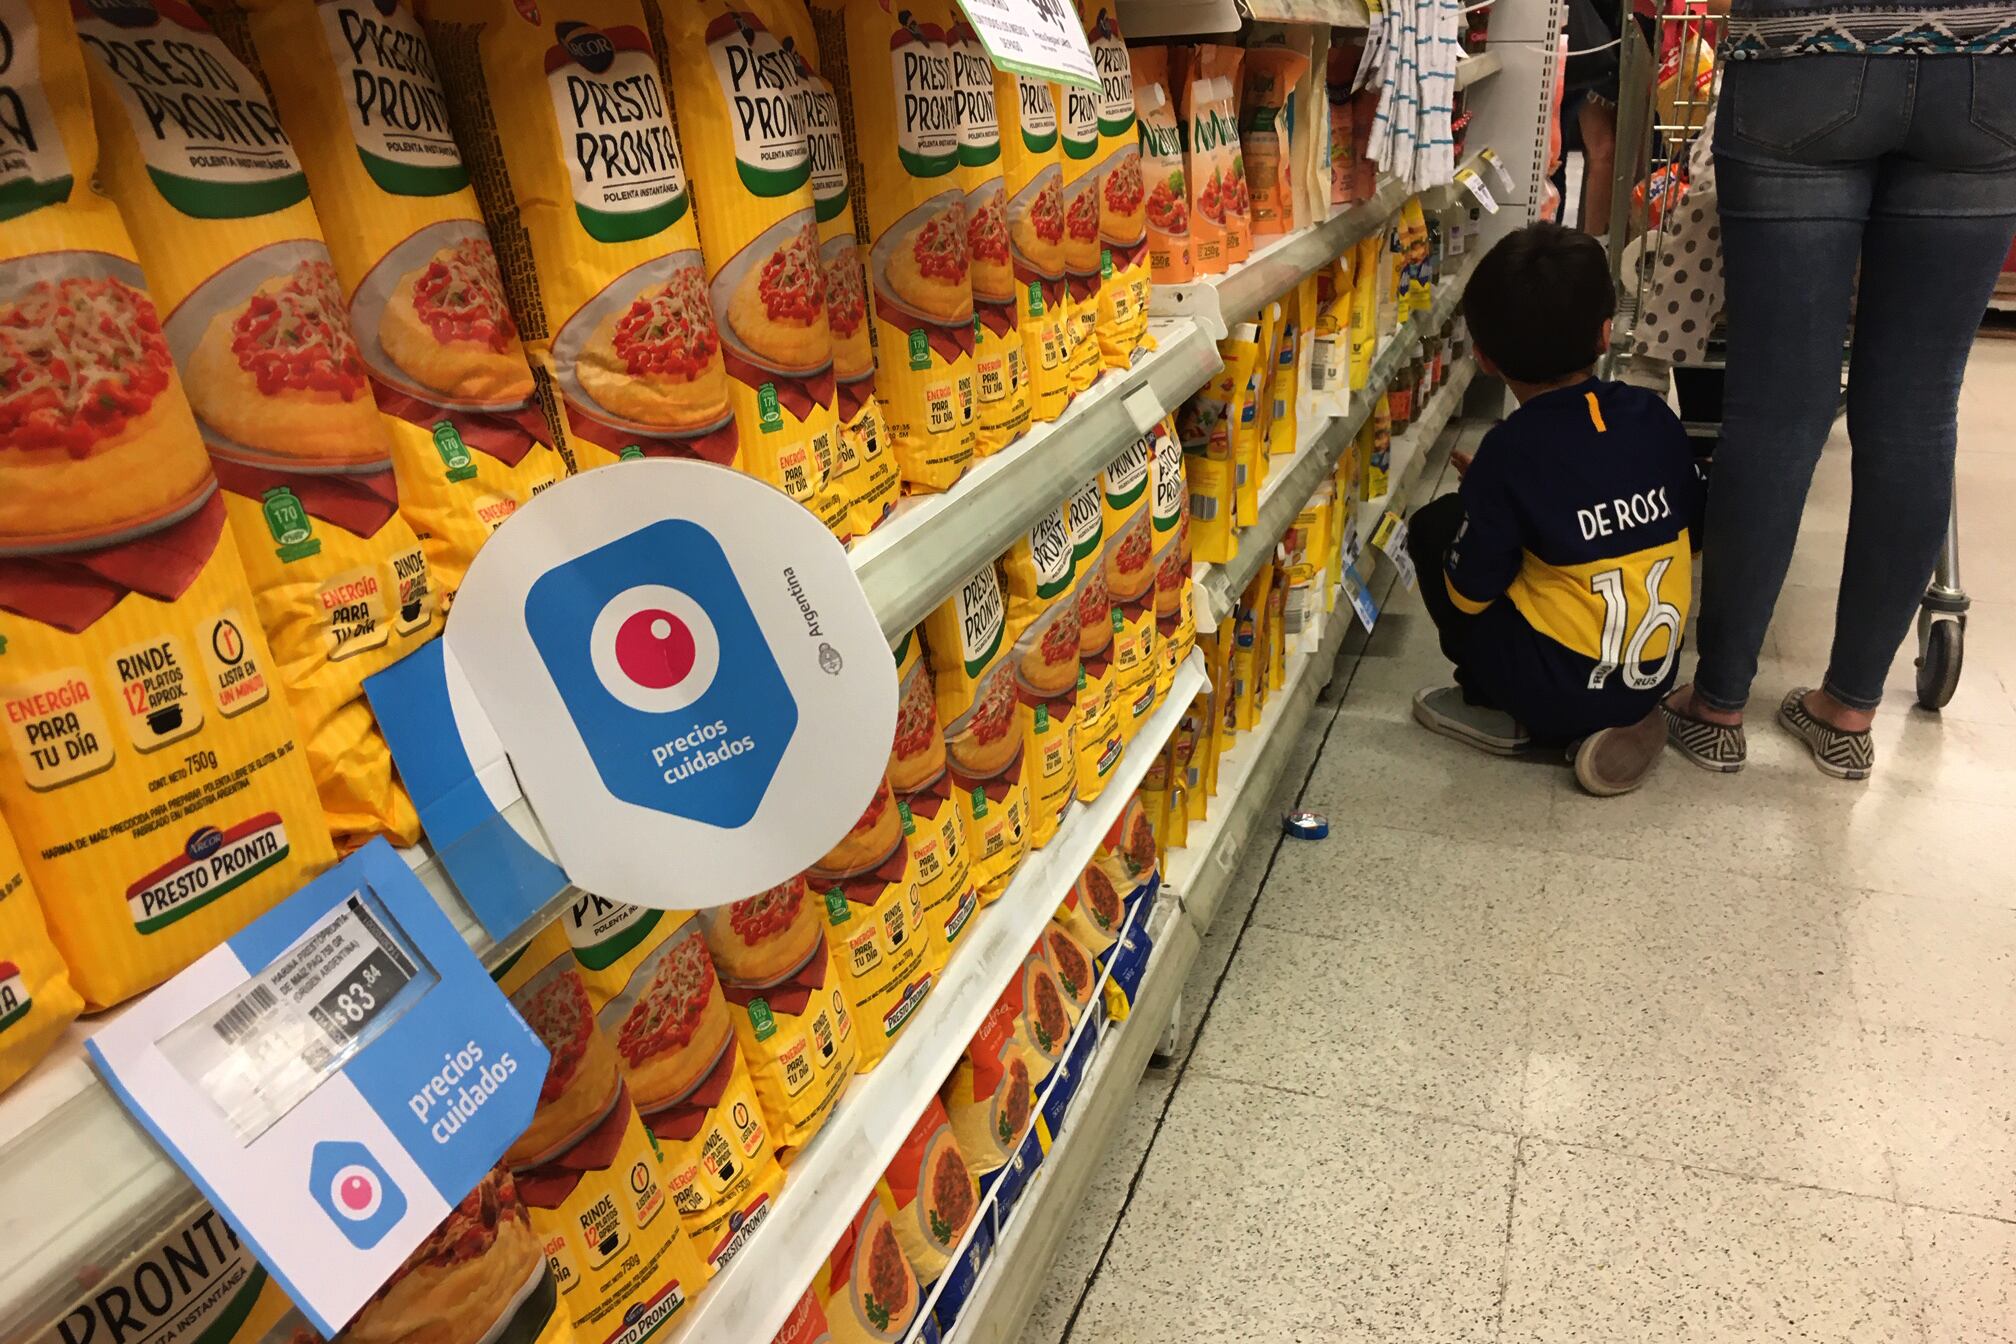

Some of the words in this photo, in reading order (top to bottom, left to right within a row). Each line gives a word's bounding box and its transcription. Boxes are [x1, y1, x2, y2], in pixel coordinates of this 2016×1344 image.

[127, 82, 291, 146] PRONTA
[566, 73, 664, 129] PRESTO
[575, 125, 680, 182] PRONTA
[603, 186, 640, 204] POLENTA
[982, 384, 993, 396] TU
[983, 371, 999, 384] PARA
[931, 400, 949, 413] PARA
[931, 413, 943, 425] TU
[943, 410, 954, 422] DÍA
[441, 437, 459, 451] 170
[784, 483, 796, 496] TU
[796, 478, 808, 492] DÍA
[785, 465, 803, 483] PARA
[274, 505, 298, 523] 170
[1577, 502, 1614, 541] DE
[393, 550, 425, 581] RINDE
[321, 575, 379, 610] ENERGÍA
[783, 566, 824, 637] Argentina
[332, 601, 370, 626] PARA
[965, 583, 1001, 648] PRONTA
[1586, 556, 1682, 691] 16
[332, 627, 352, 646] TU
[353, 618, 376, 638] DÍA
[116, 642, 177, 682] RINDE
[218, 665, 242, 689] LISTA
[241, 659, 257, 679] EN
[4, 679, 91, 724] ENERGÍA
[122, 682, 150, 717] 12
[143, 666, 184, 692] PLATOS
[148, 684, 188, 709] APROX.
[219, 688, 236, 706] UN
[25, 711, 81, 745] PARA
[30, 749, 61, 771] TU
[66, 732, 99, 760] DÍA
[651, 719, 728, 768] precios
[184, 749, 219, 777] 750g
[663, 735, 755, 785] cuidados
[74, 836, 88, 851] DE
[140, 865, 208, 917] PRESTO
[210, 831, 278, 881] PRONTA
[919, 852, 935, 868] PARA
[919, 867, 929, 879] TU
[929, 860, 940, 873] DÍA
[594, 911, 629, 937] POLENTA
[884, 900, 903, 923] RINDE
[854, 940, 873, 958] PARA
[854, 957, 865, 969] TU
[865, 948, 878, 963] DÍA
[270, 958, 299, 986] HARINA
[279, 981, 293, 996] DE
[887, 1004, 909, 1029] PRESTO
[786, 1054, 804, 1075] PARA
[787, 1073, 798, 1086] TU
[799, 1063, 809, 1079] DÍA
[407, 1039, 484, 1125] precios
[430, 1051, 519, 1145] cuidados
[636, 1192, 651, 1211] LISTA
[649, 1181, 658, 1195] EN
[579, 1193, 614, 1231] RINDE
[583, 1226, 600, 1249] 12
[717, 1237, 742, 1269] PRESTO
[741, 1204, 768, 1239] PRONTA
[177, 1266, 249, 1333] INSTANTÁNEA
[637, 1292, 680, 1335] PRONTA
